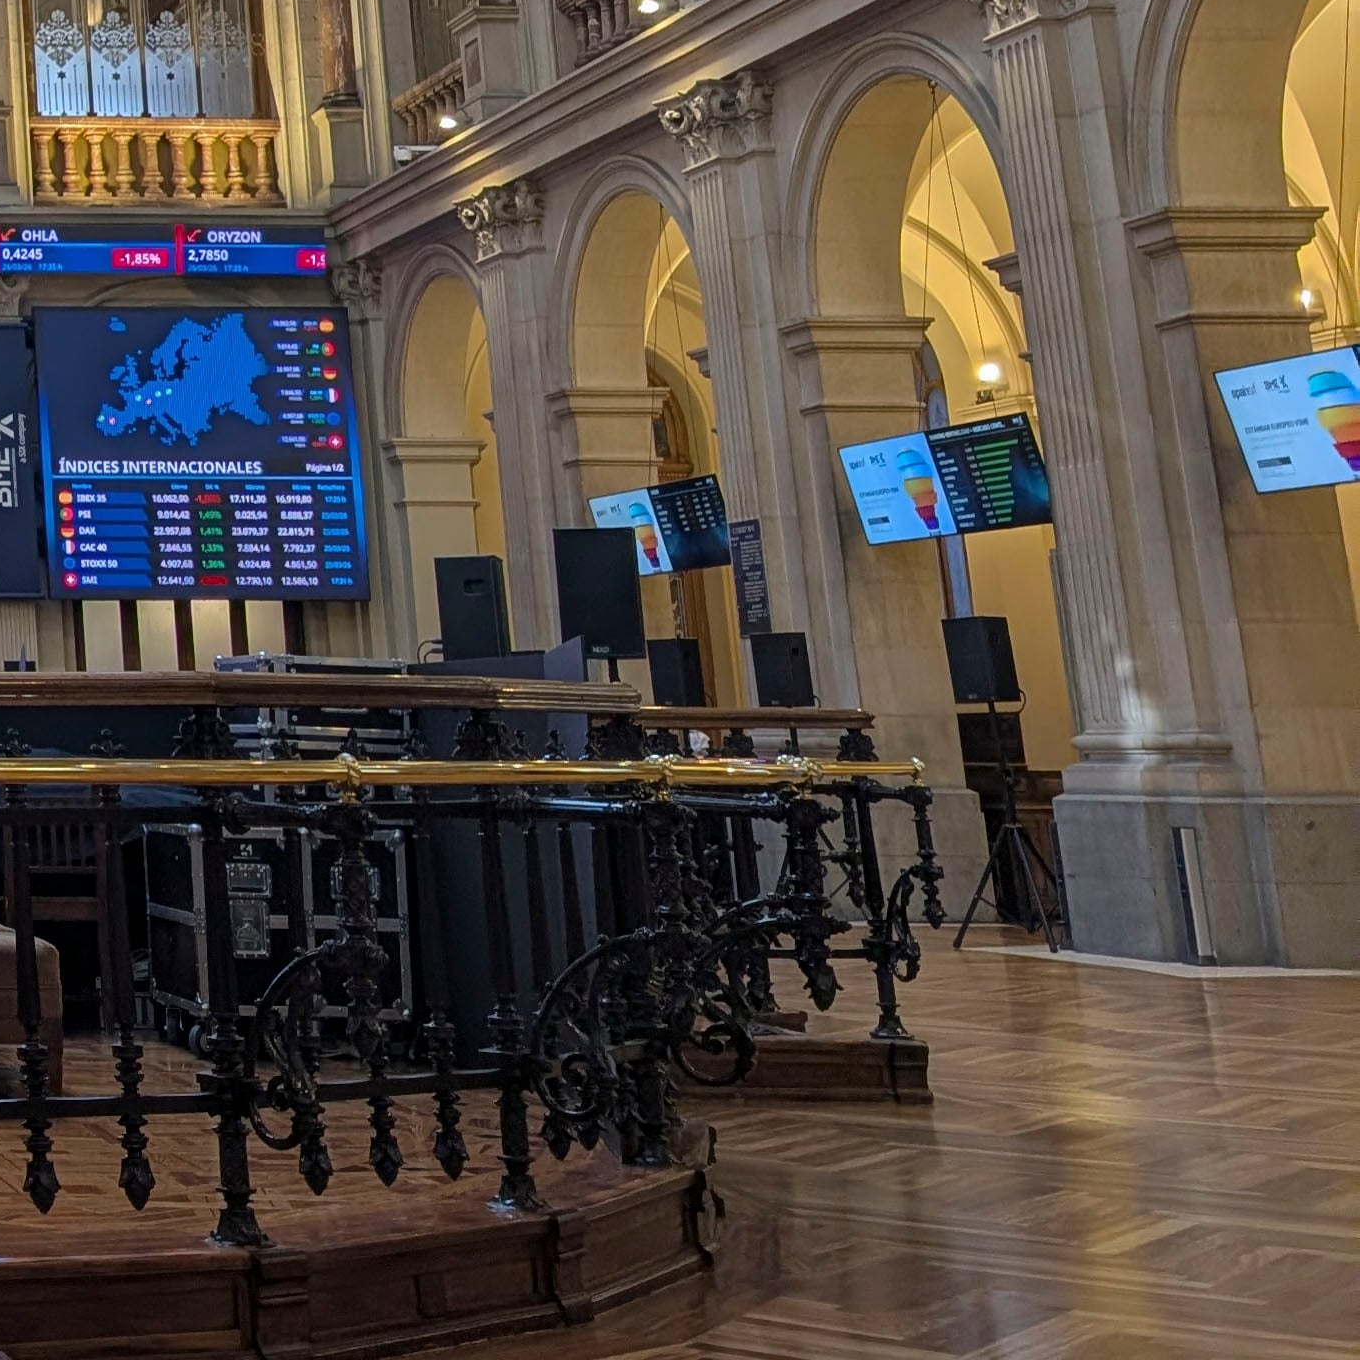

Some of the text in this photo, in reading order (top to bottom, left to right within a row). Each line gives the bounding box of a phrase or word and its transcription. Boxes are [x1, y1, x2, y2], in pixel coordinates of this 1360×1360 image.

[22, 230, 58, 242] OHLA
[207, 231, 261, 243] ORYZON
[2, 248, 43, 261] 0,4245
[120, 252, 161, 266] -1,85%
[188, 249, 228, 262] 2,7850
[59, 458, 263, 474] ÍNDICES INTERNACIONALES
[305, 464, 344, 474] Página 1/2
[79, 527, 96, 535] DAX
[80, 544, 107, 552] CAC 40
[81, 560, 118, 568] STOXX 50
